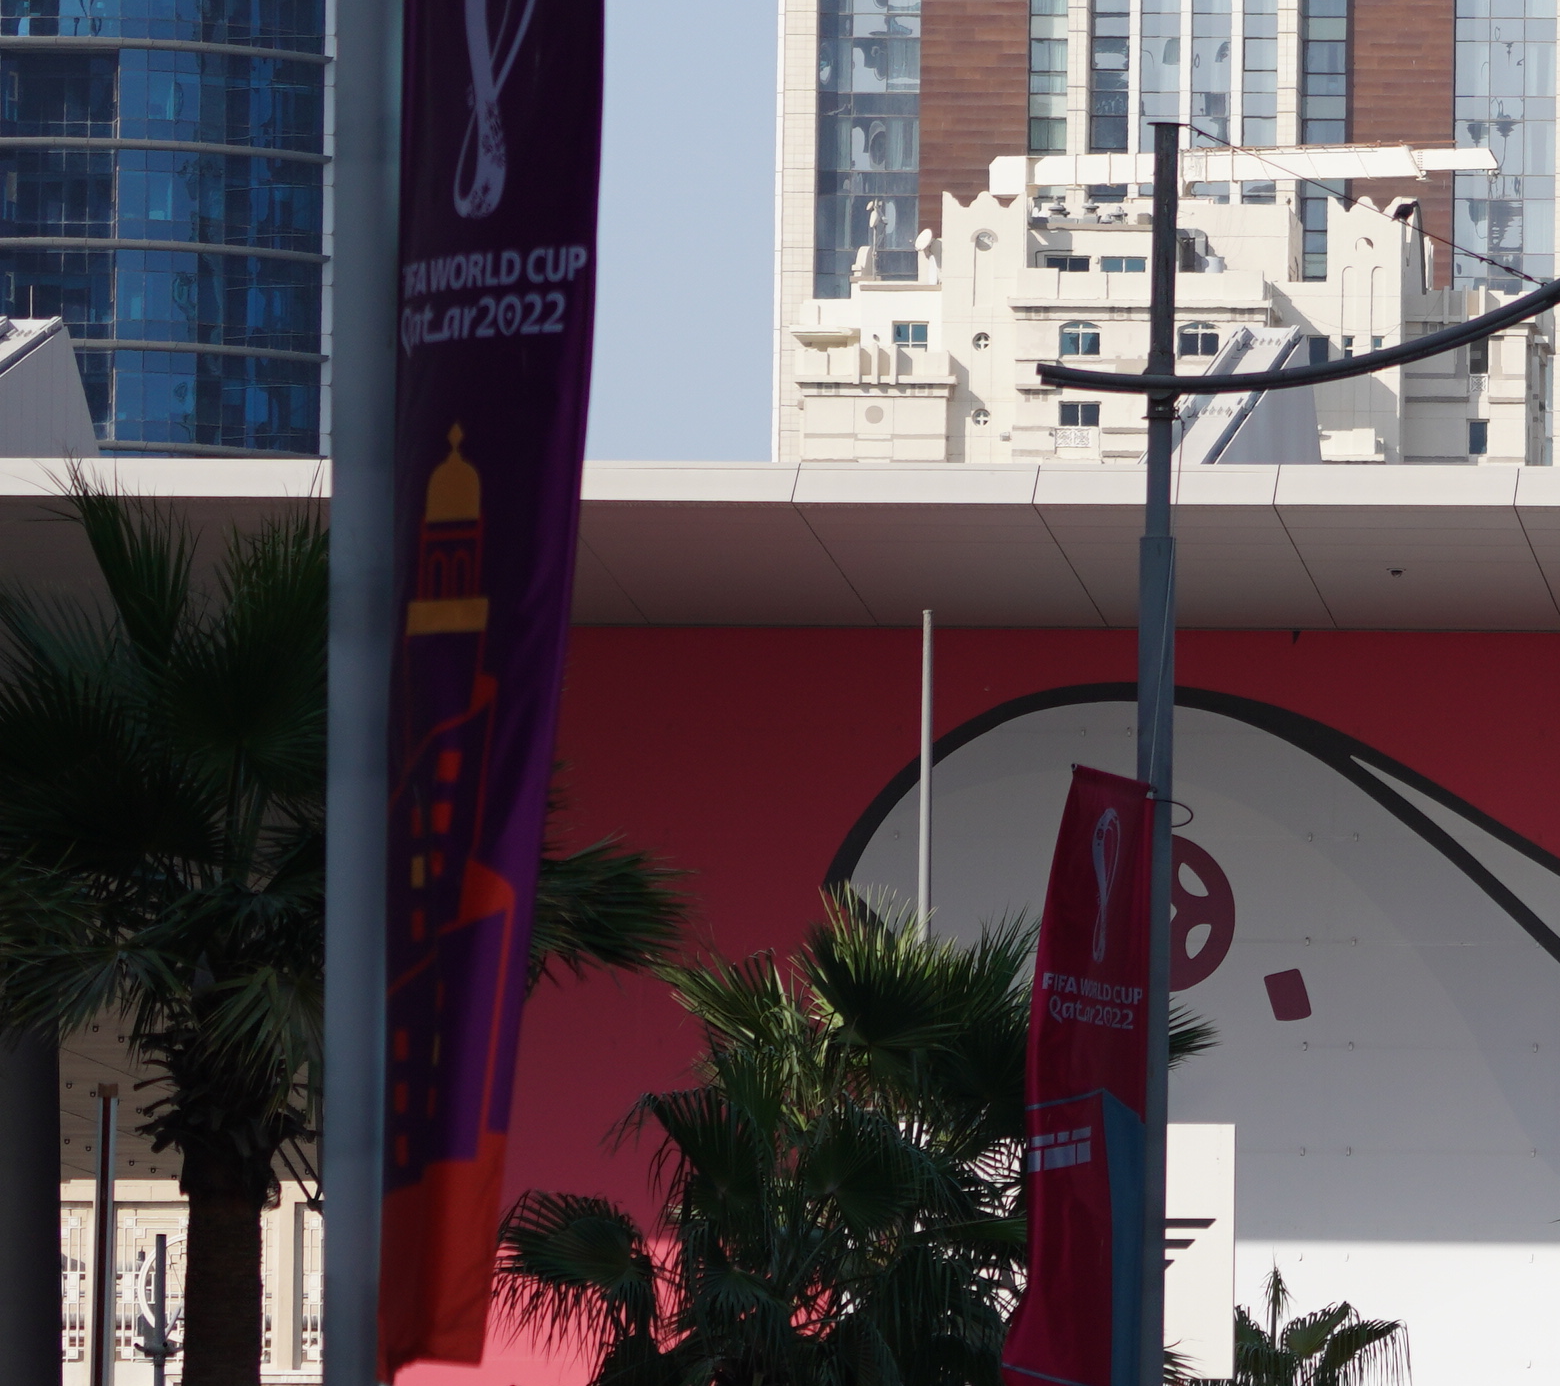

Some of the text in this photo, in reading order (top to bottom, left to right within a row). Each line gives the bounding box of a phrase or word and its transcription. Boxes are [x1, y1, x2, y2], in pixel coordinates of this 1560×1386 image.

[430, 250, 522, 292] WORLD
[526, 244, 588, 284] CUP
[1042, 972, 1078, 994] FIFA
[1113, 986, 1143, 1004] CUP
